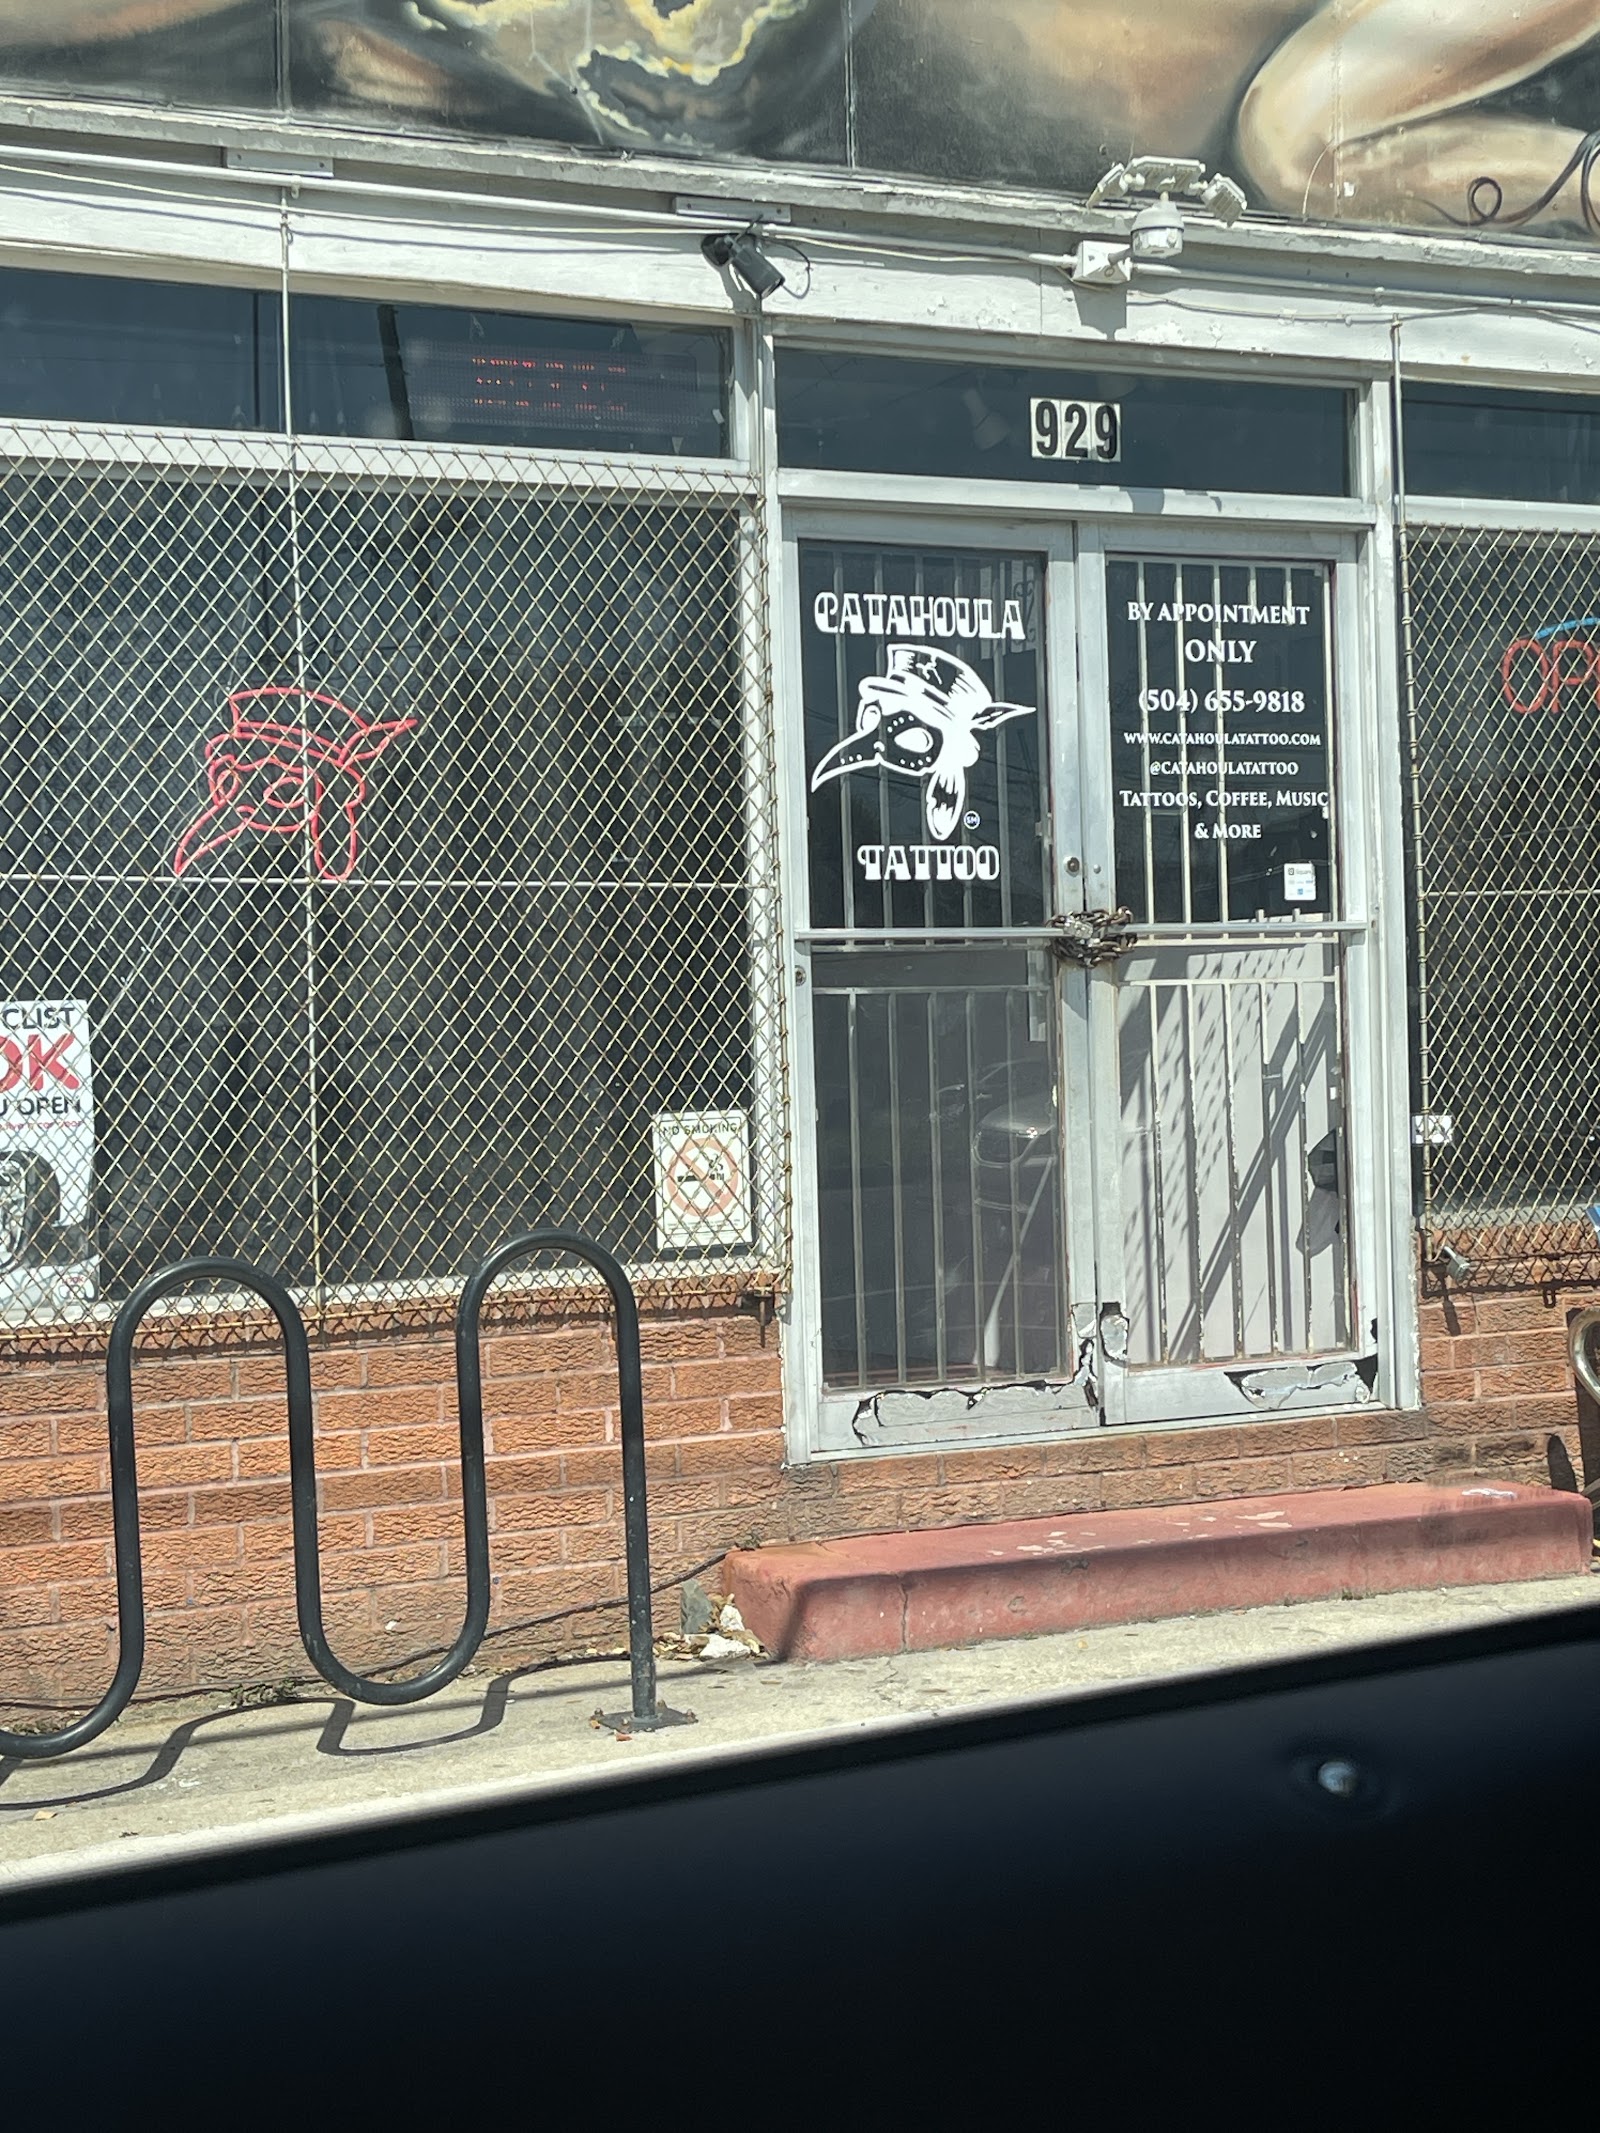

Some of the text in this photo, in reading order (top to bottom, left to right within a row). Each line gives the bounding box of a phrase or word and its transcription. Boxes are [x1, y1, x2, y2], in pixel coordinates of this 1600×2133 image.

[1035, 400, 1118, 460] 929
[814, 592, 1026, 640] CATAHOULA
[1127, 602, 1310, 625] BY APPOINTMENT
[1185, 639, 1257, 664] ONLY
[1503, 638, 1600, 714] OP
[1138, 688, 1306, 714] (504) 655-9818
[1124, 732, 1321, 746] WWW.CATAHOULATATTOO.COM
[1150, 761, 1299, 776] @CATAHOULATATTOO
[1194, 823, 1262, 839] & MORE
[857, 845, 1000, 881] TATTOO
[19, 1096, 81, 1116] OPEN
